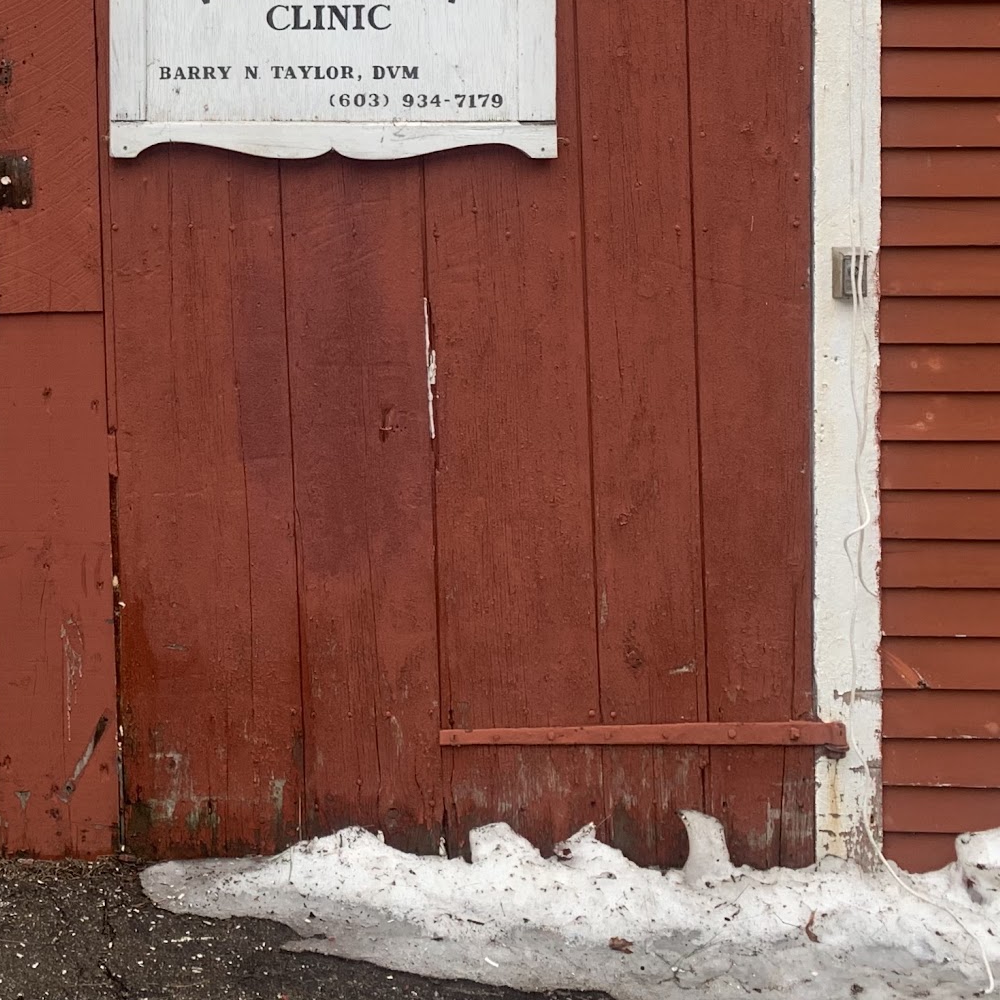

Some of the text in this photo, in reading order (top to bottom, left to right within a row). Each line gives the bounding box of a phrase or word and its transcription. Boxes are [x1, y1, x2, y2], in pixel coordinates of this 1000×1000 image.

[265, 3, 393, 31] CLINIC
[158, 66, 232, 81] BARRY
[271, 65, 363, 82] TAYLOR,
[372, 66, 420, 81] DVM
[328, 93, 504, 110] (603) 934-7179
